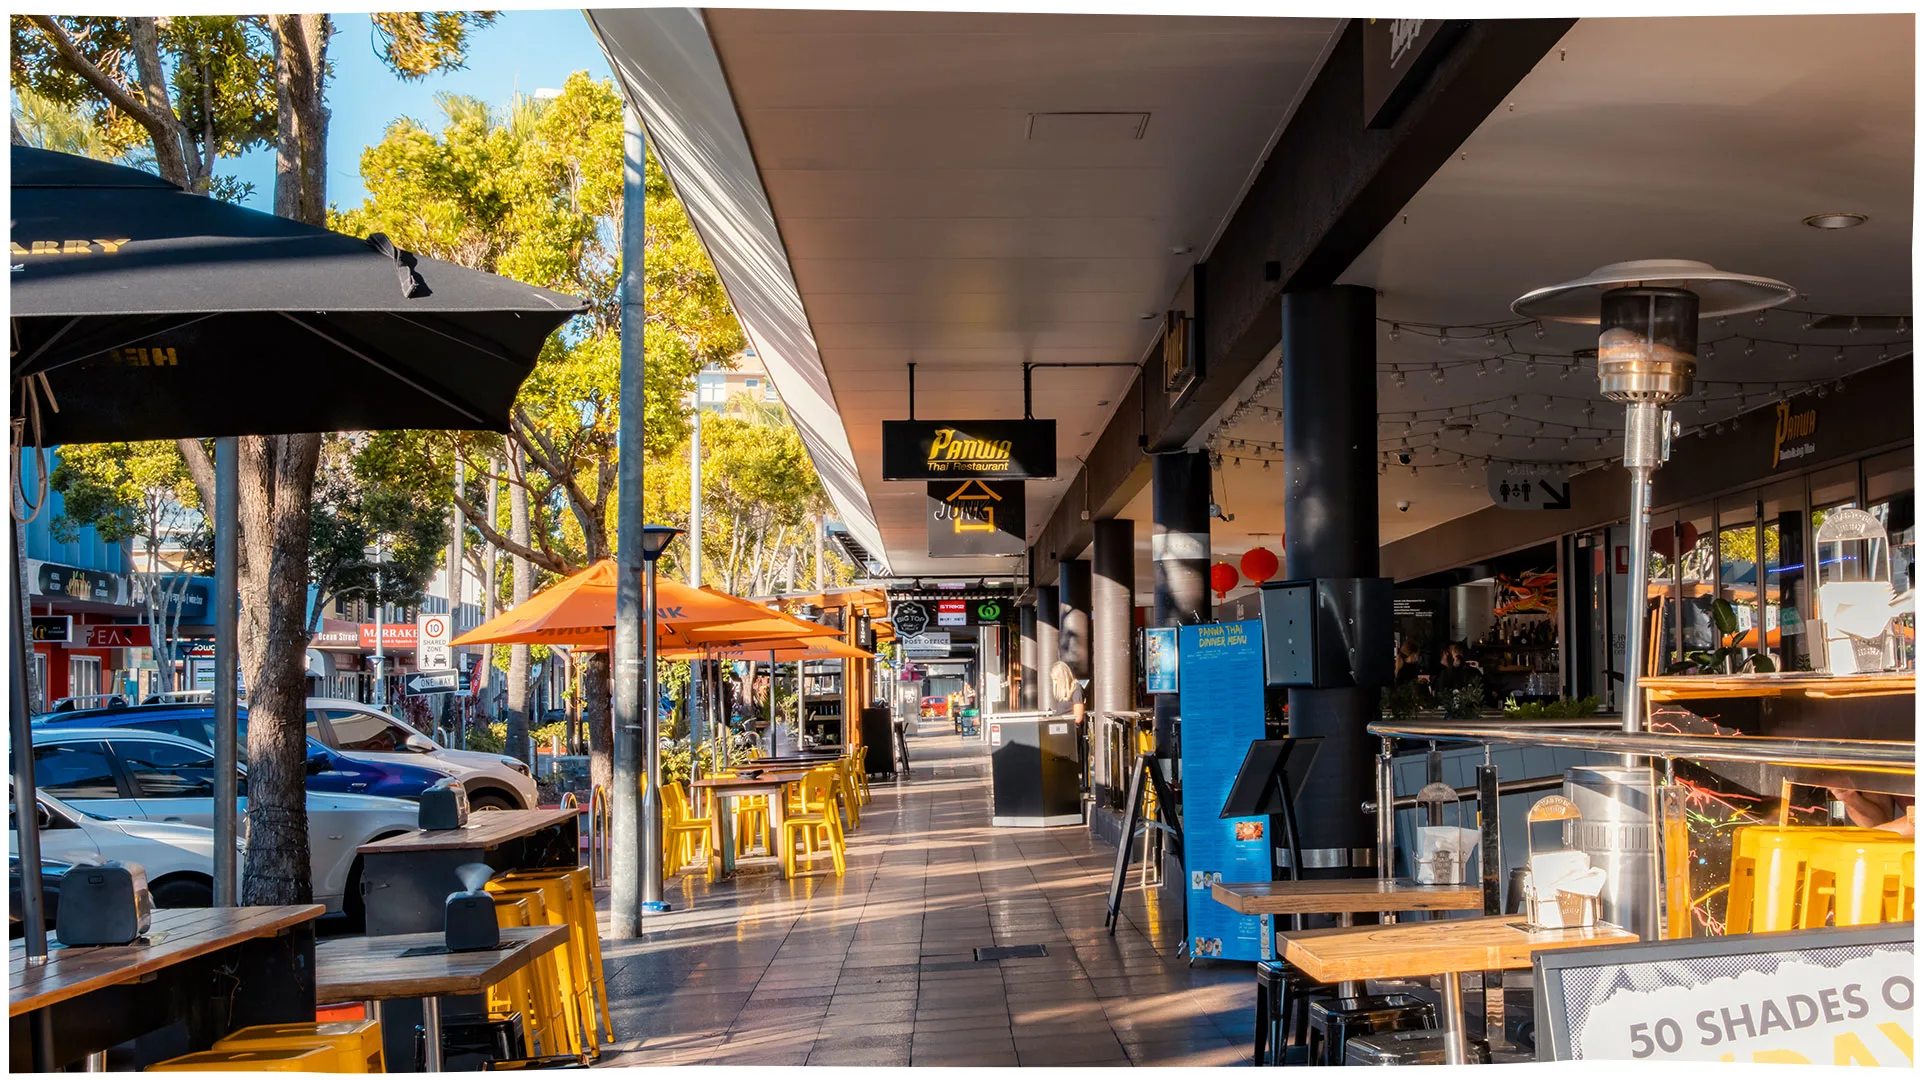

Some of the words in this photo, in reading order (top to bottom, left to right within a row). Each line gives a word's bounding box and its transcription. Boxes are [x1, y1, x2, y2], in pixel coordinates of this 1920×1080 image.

[928, 462, 949, 471] Thai
[954, 462, 1009, 471] Restaurant
[430, 624, 439, 633] 10
[1198, 626, 1224, 637] PANWA
[1225, 624, 1243, 635] THAI
[318, 632, 338, 641] Ocean
[339, 632, 358, 641] Street
[1199, 637, 1227, 648] DINNER
[1227, 635, 1247, 646] MENU
[421, 678, 435, 688] ONE
[439, 678, 452, 687] WAY
[1629, 1017, 1683, 1059] 50
[1696, 983, 1870, 1047] SHADES
